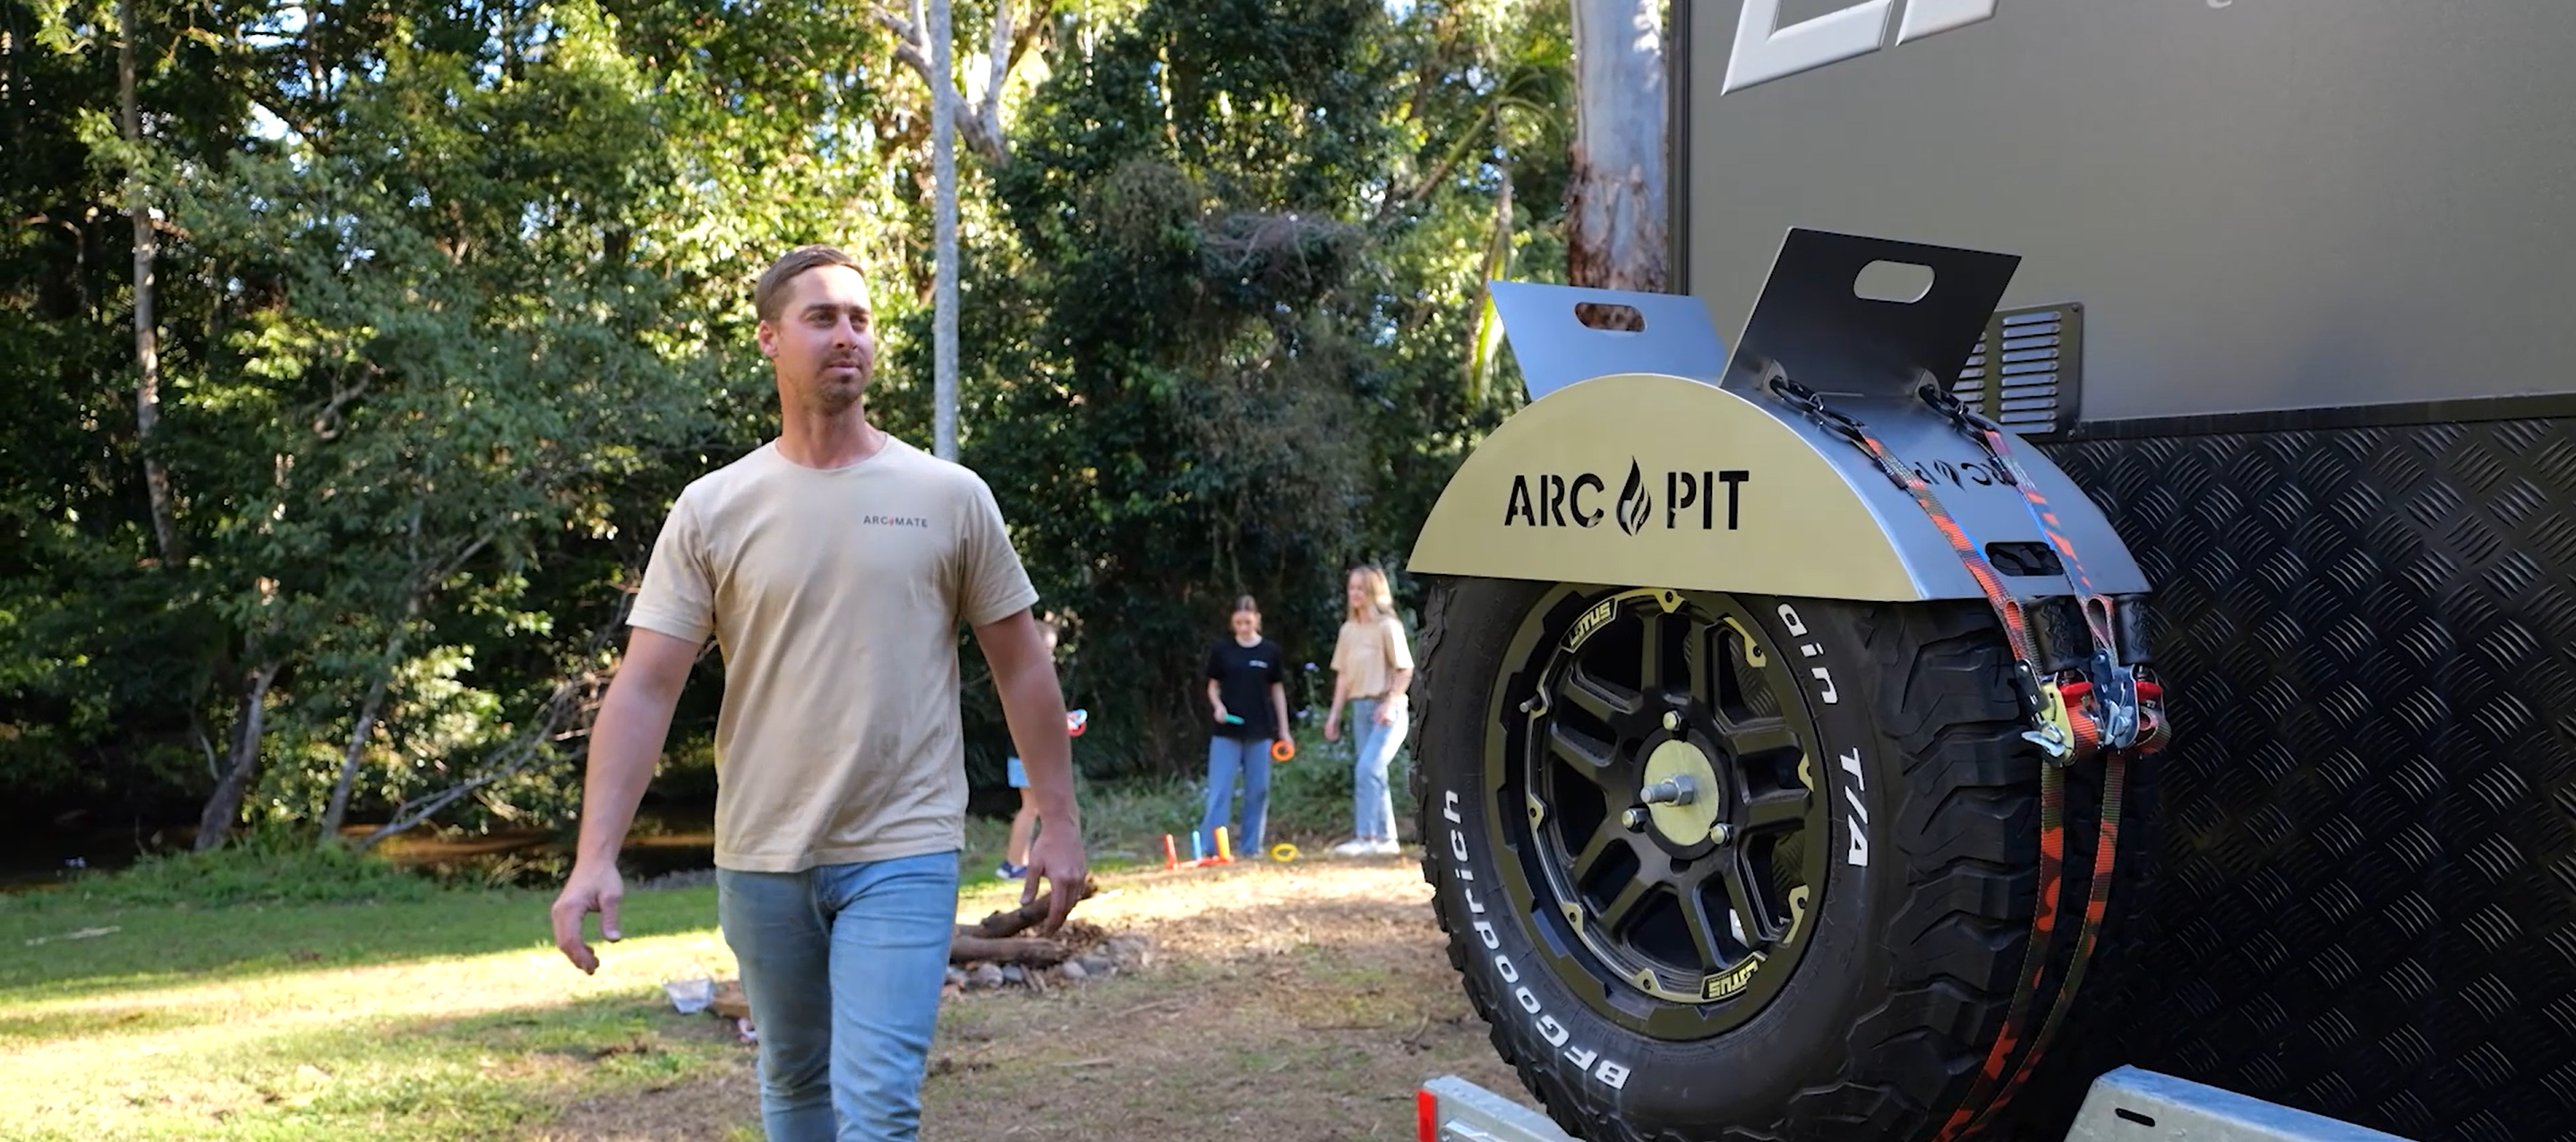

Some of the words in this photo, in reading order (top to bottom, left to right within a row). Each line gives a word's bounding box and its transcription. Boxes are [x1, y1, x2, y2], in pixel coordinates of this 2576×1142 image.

[1504, 472, 1605, 528] ARC
[1666, 470, 1749, 530] PIT
[1568, 601, 1612, 647] LOTUS
[1840, 747, 1869, 866] T/A
[1443, 789, 1631, 1090] BFGoodrich
